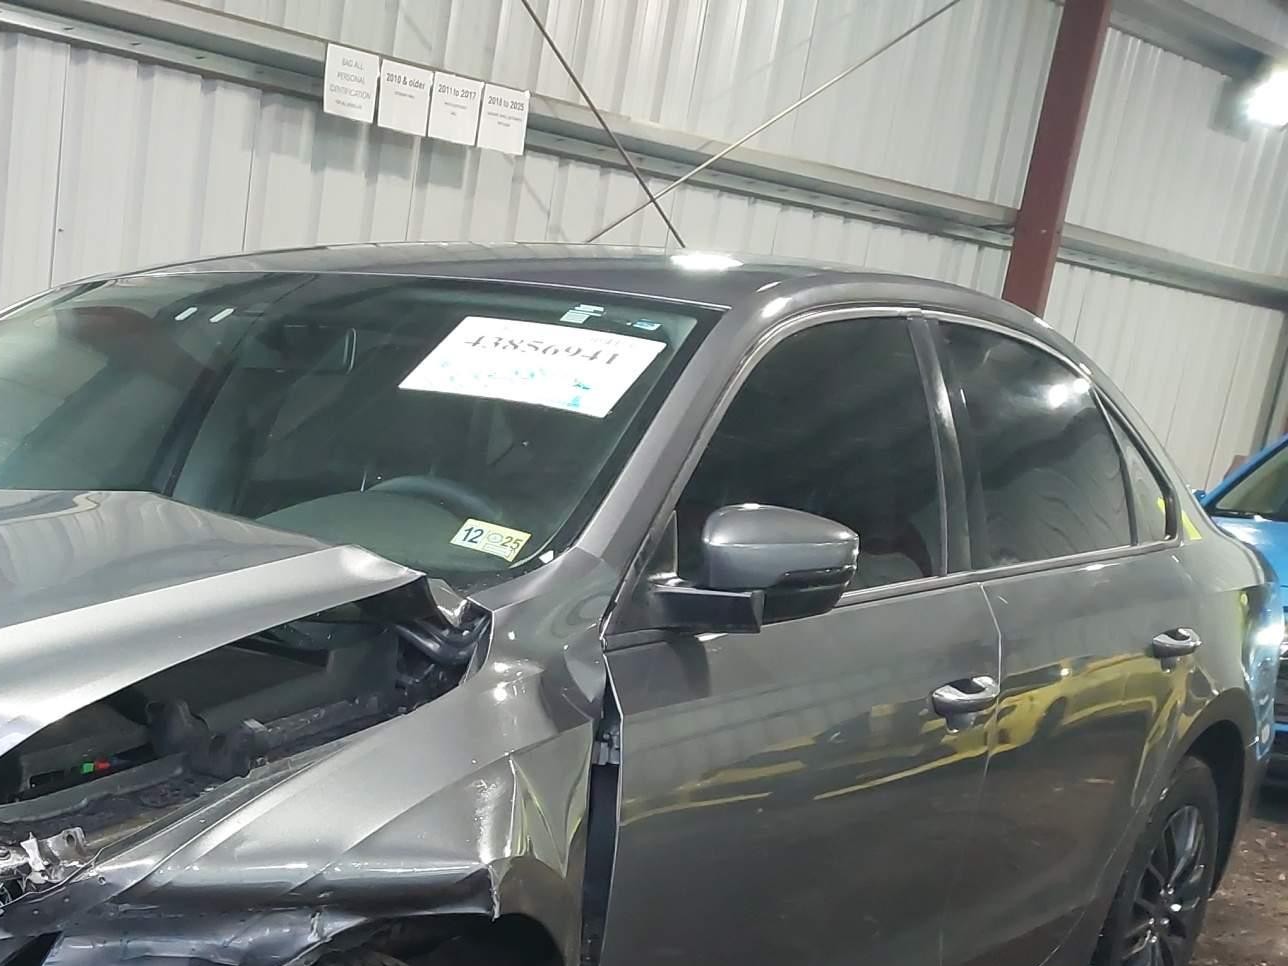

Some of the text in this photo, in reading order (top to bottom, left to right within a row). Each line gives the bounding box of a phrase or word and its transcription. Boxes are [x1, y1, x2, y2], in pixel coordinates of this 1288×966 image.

[386, 72, 425, 90] 2010 & older
[438, 83, 452, 95] 2011
[460, 88, 477, 100] 2017
[464, 335, 619, 365] 43856941
[462, 526, 484, 544] 12
[501, 536, 523, 550] 25
